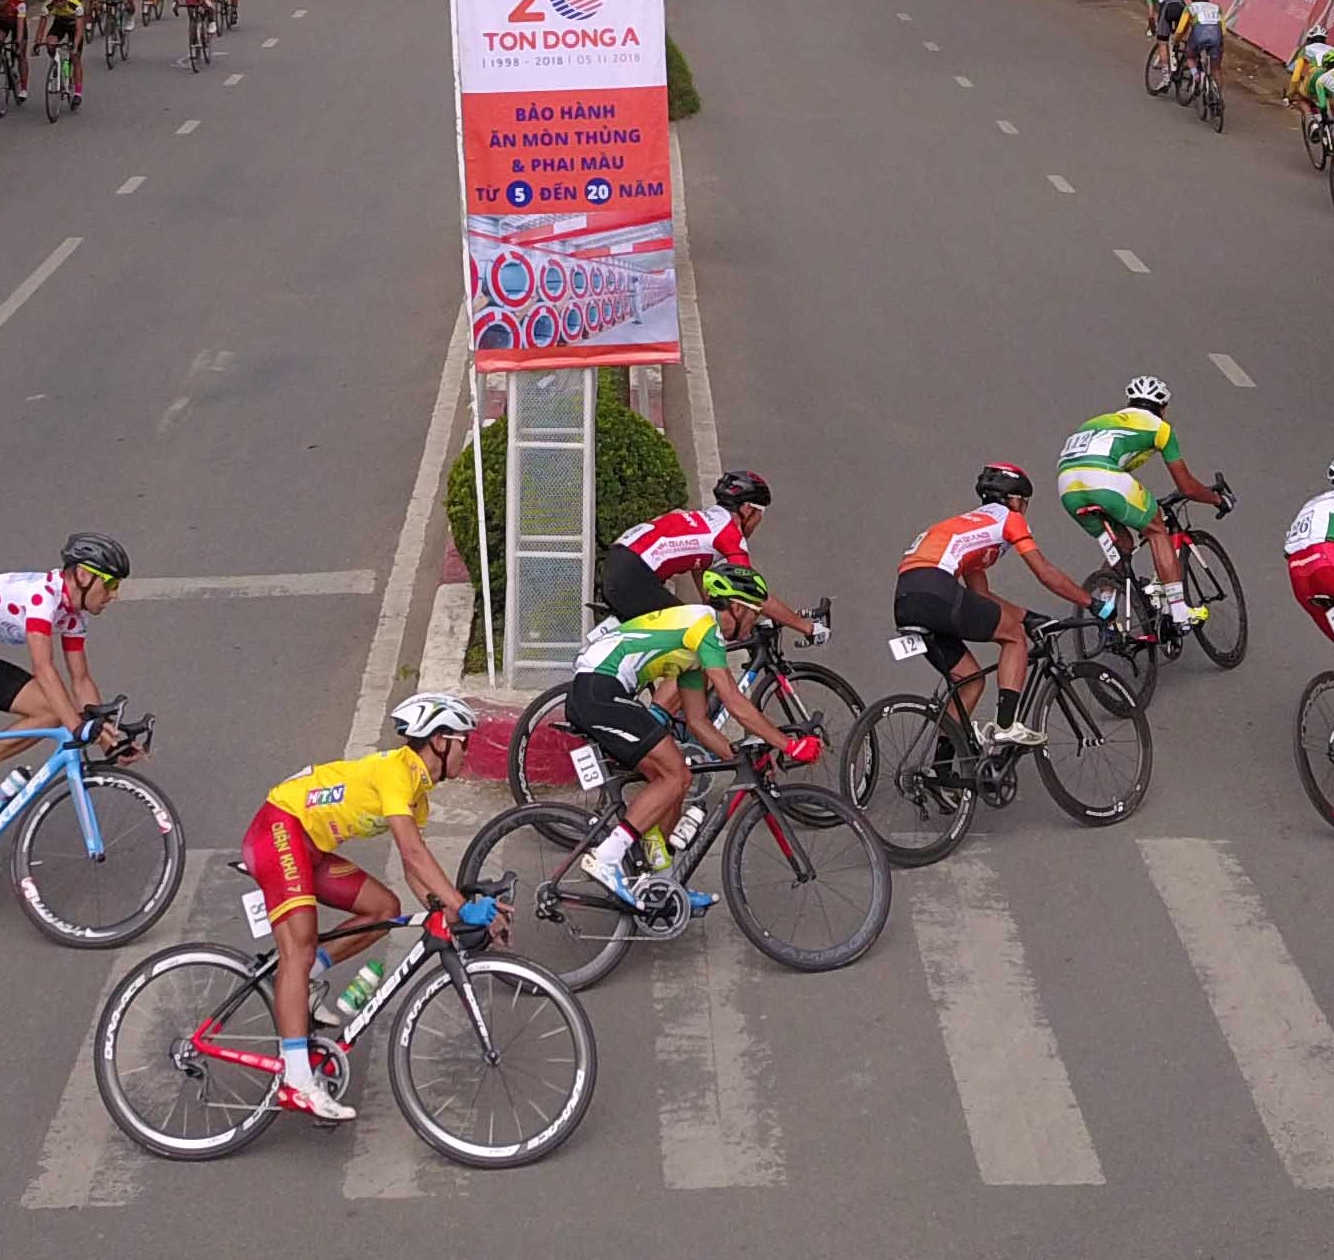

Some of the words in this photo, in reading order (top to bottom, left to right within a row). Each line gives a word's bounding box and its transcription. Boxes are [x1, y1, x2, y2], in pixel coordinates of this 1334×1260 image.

[483, 30, 537, 52] TON
[543, 27, 617, 50] DONG
[621, 26, 641, 46] A
[490, 57, 520, 68] 1998
[534, 55, 564, 66] 2018
[515, 102, 555, 122] BẢO
[560, 101, 616, 120] HÀNH
[522, 129, 568, 147] MÒN
[574, 125, 641, 146] THỦNG
[511, 158, 525, 173] &
[531, 157, 575, 172] PHAI
[581, 152, 625, 171] MÀU
[474, 184, 501, 202] TỪ
[514, 187, 525, 203] 5
[539, 182, 577, 201] ĐẾN
[586, 184, 610, 200] 20
[619, 179, 664, 198] NĂM
[574, 753, 601, 784] 113
[279, 849, 299, 882] KHU
